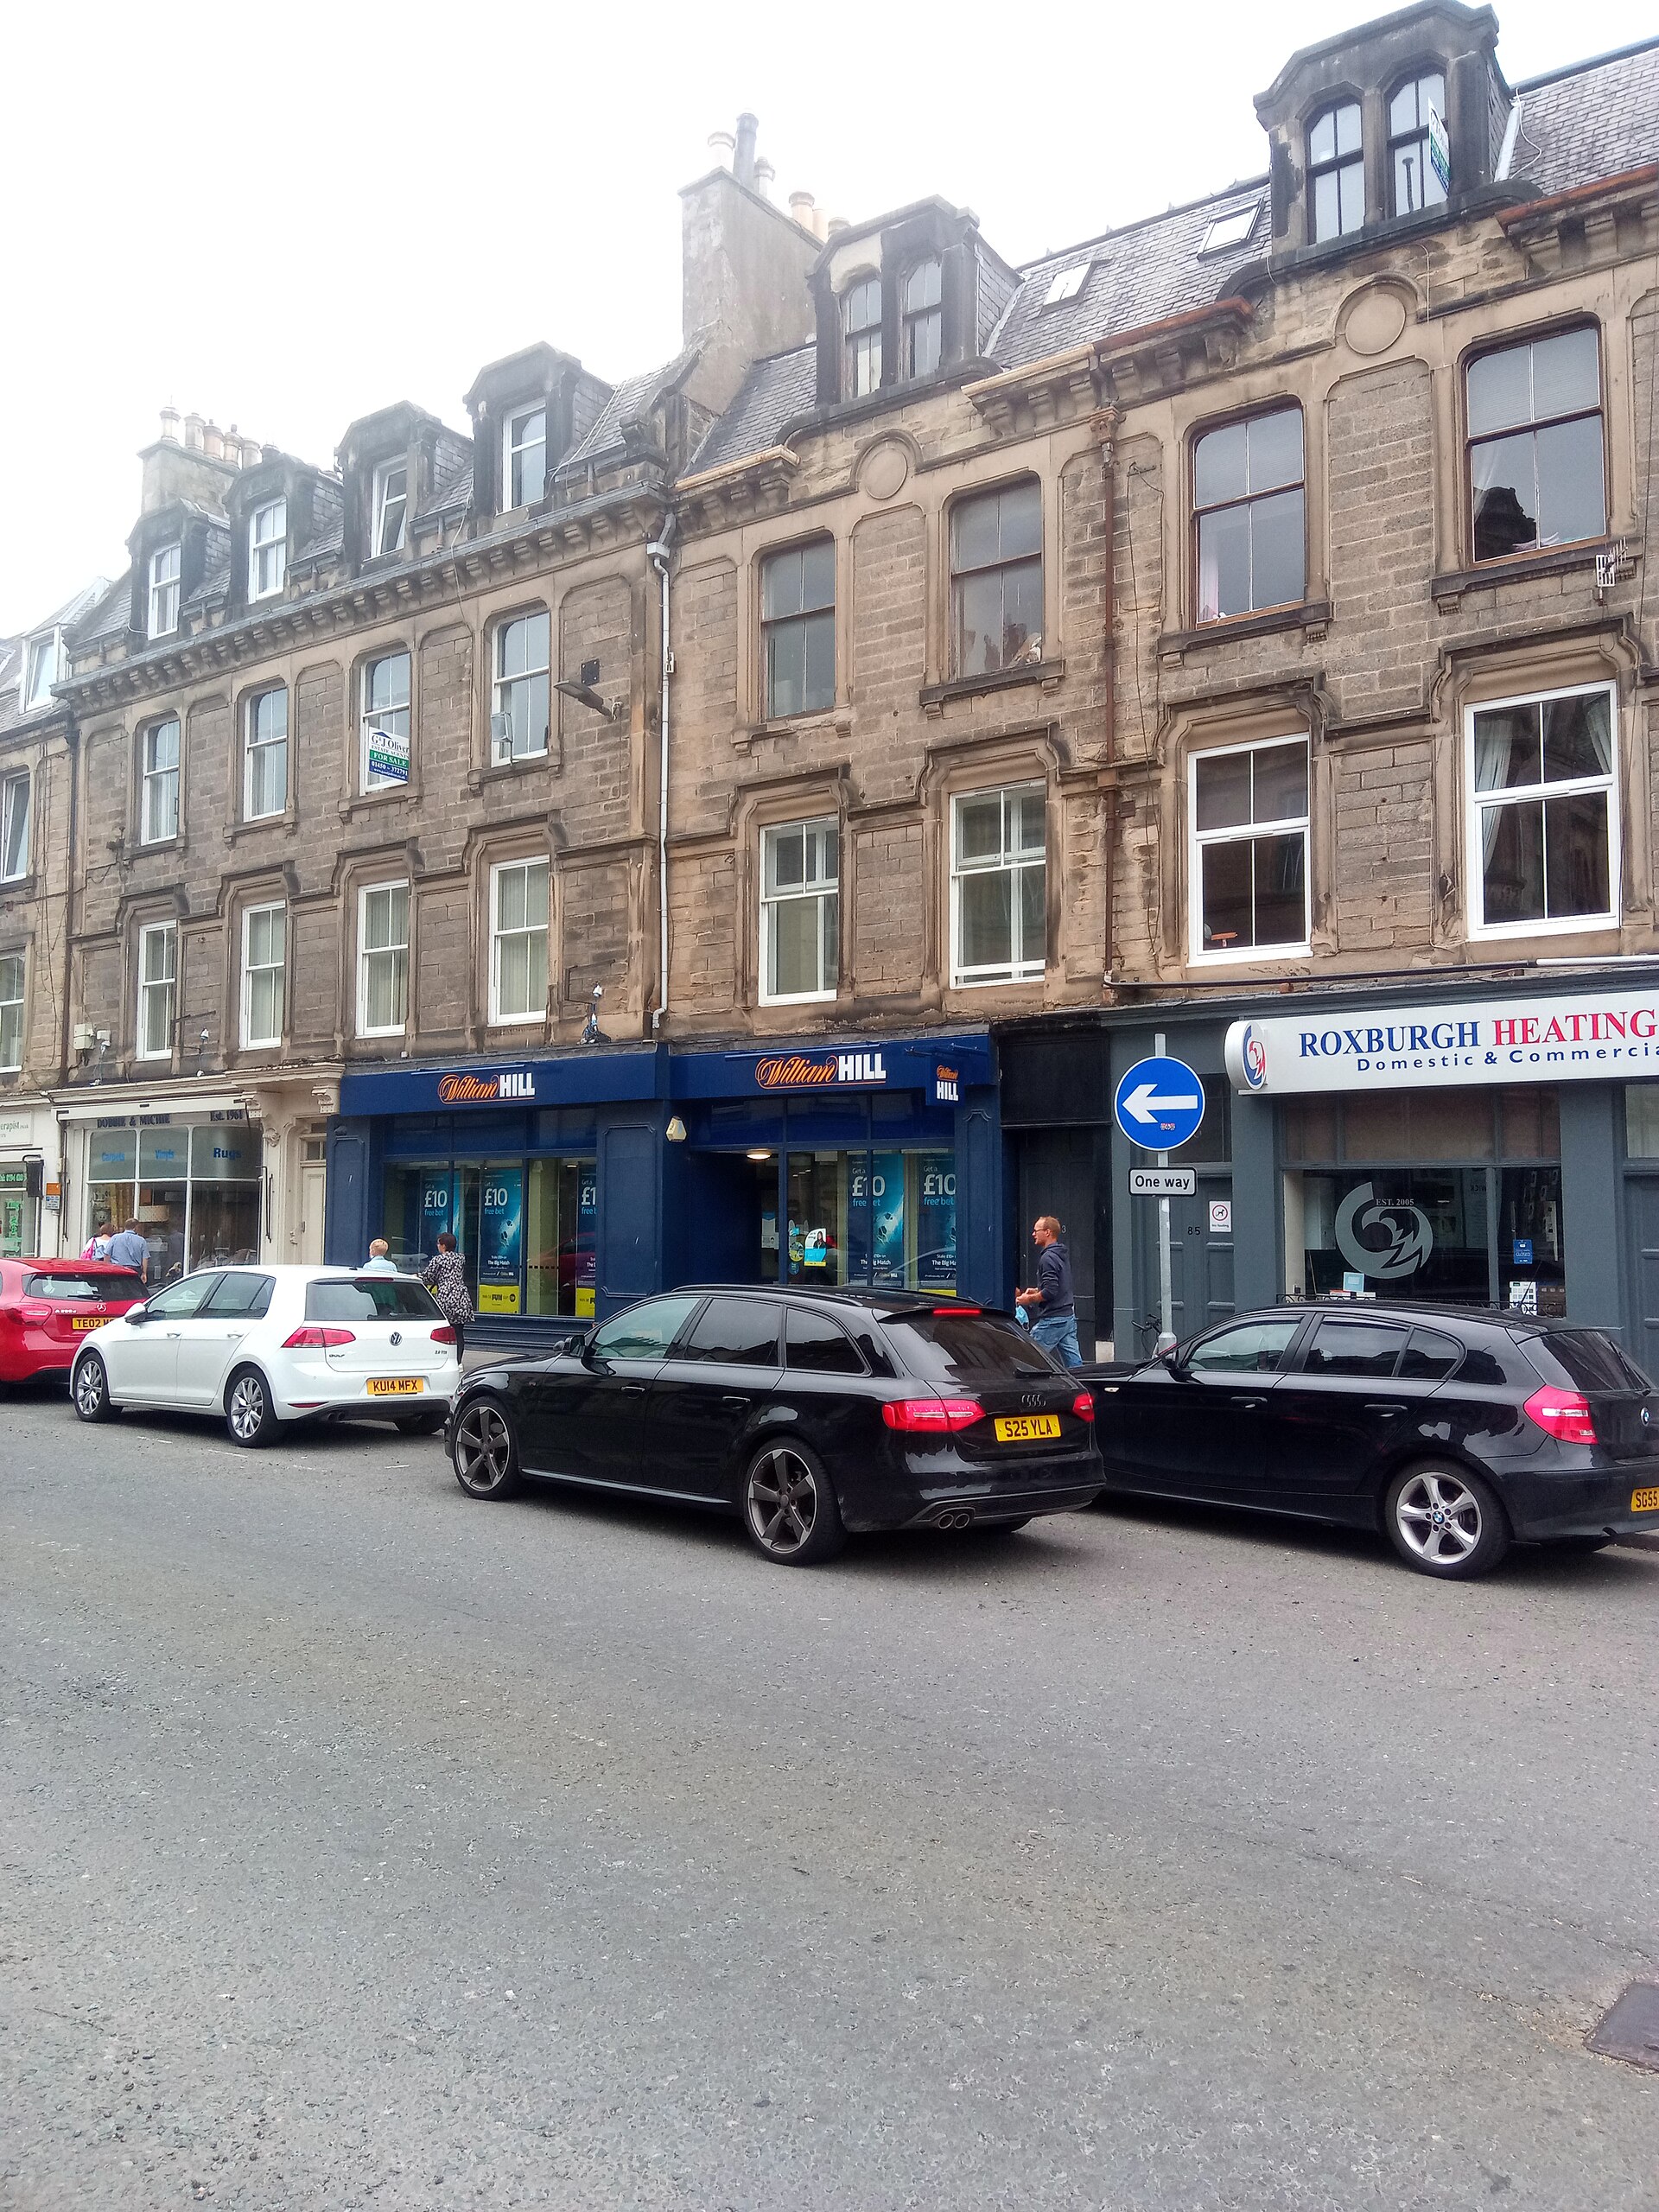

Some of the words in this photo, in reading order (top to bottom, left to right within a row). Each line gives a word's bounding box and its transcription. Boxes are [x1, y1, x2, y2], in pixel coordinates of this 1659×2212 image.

[388, 740, 410, 753] Oliver
[373, 752, 387, 761] FOR
[388, 757, 407, 766] SALE
[1298, 1020, 1481, 1058] ROXBURGH
[1491, 1008, 1658, 1046] HEATING
[1357, 1052, 1473, 1071] Domestic
[1484, 1051, 1498, 1065] &
[755, 1055, 838, 1087] William
[838, 1053, 887, 1081] HILL
[937, 1065, 958, 1079] William
[437, 1074, 500, 1102] William
[499, 1072, 535, 1097] HILL
[937, 1080, 959, 1101] HILL
[102, 1152, 125, 1162] Carpets
[213, 1147, 242, 1160] Rugs
[852, 1175, 886, 1197] £10
[923, 1173, 957, 1195] £10
[1135, 1175, 1160, 1187] One
[1164, 1178, 1190, 1190] way
[424, 1190, 448, 1208] £10
[484, 1187, 508, 1206] £10
[924, 1197, 939, 1205] free
[940, 1197, 955, 1205] bet
[76, 1319, 101, 1328] TE02
[373, 1381, 396, 1392] KU14
[398, 1380, 417, 1390] MFX
[1004, 1420, 1028, 1438] S25
[1030, 1419, 1053, 1435] YLA
[1635, 1491, 1658, 1508] SG55
